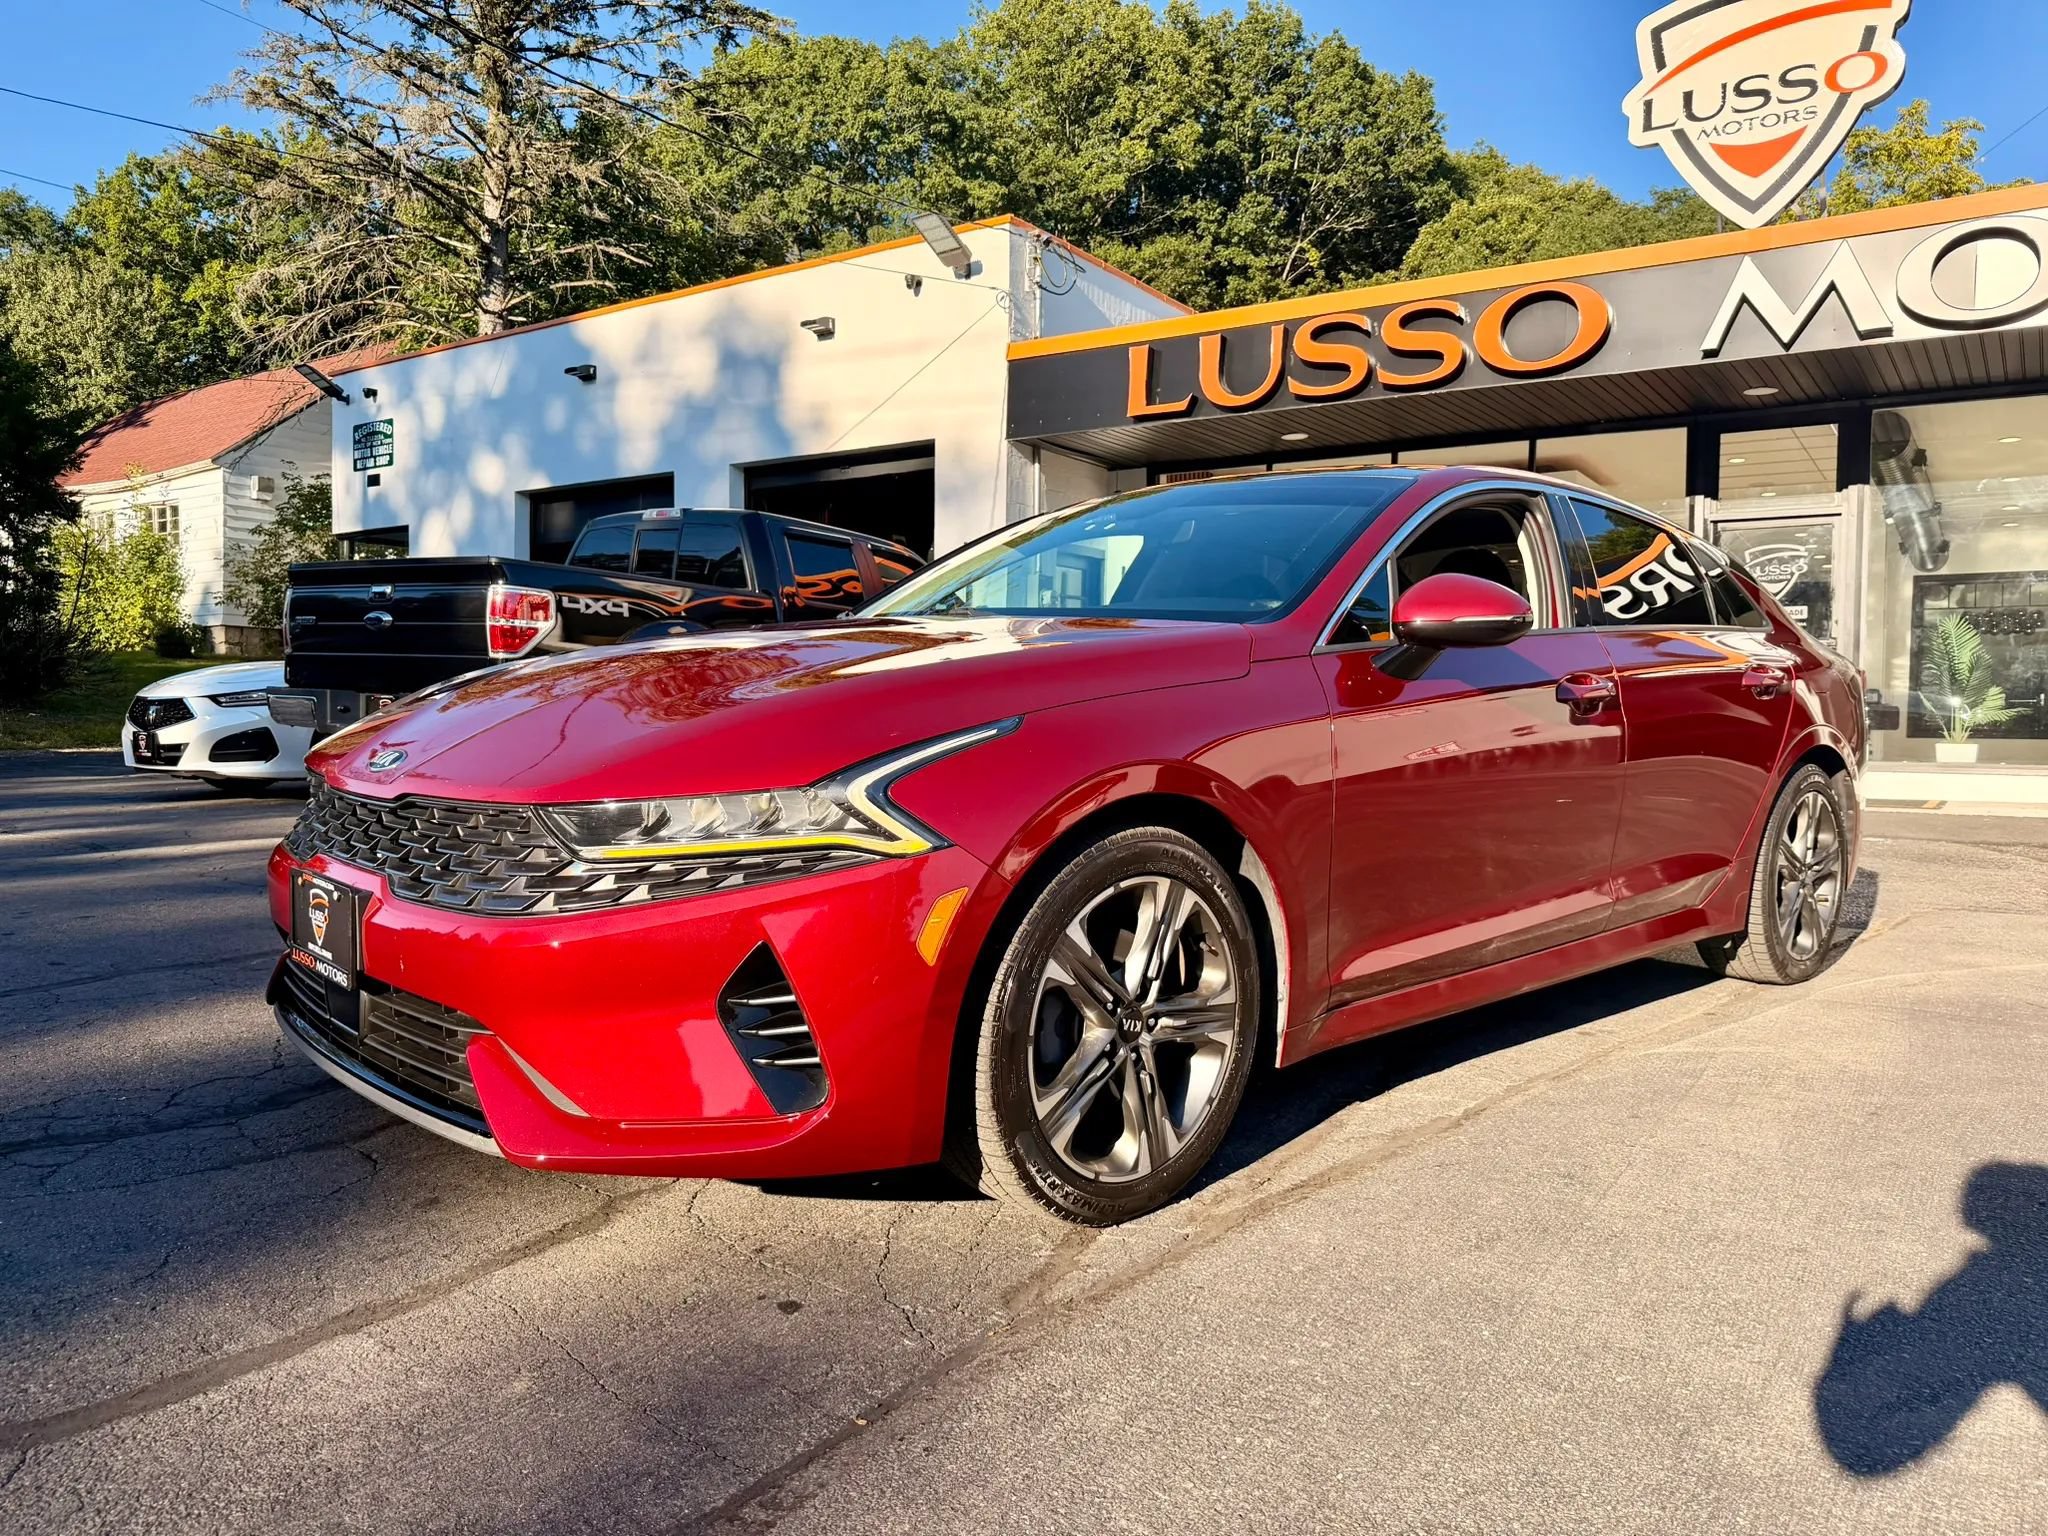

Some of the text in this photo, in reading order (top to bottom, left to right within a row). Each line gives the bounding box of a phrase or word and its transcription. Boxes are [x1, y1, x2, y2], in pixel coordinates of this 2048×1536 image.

[1642, 51, 1888, 133] LUSSO
[1697, 105, 1819, 141] MOTORS
[1126, 215, 2048, 420] LUSSO MO
[354, 422, 392, 441] REGISTERED
[356, 455, 390, 469] REPAIR SHOP
[372, 444, 392, 456] VEHICLE
[292, 948, 315, 968] LUSSO
[315, 960, 348, 988] MOTORS
[1122, 1018, 1142, 1032] KIA
